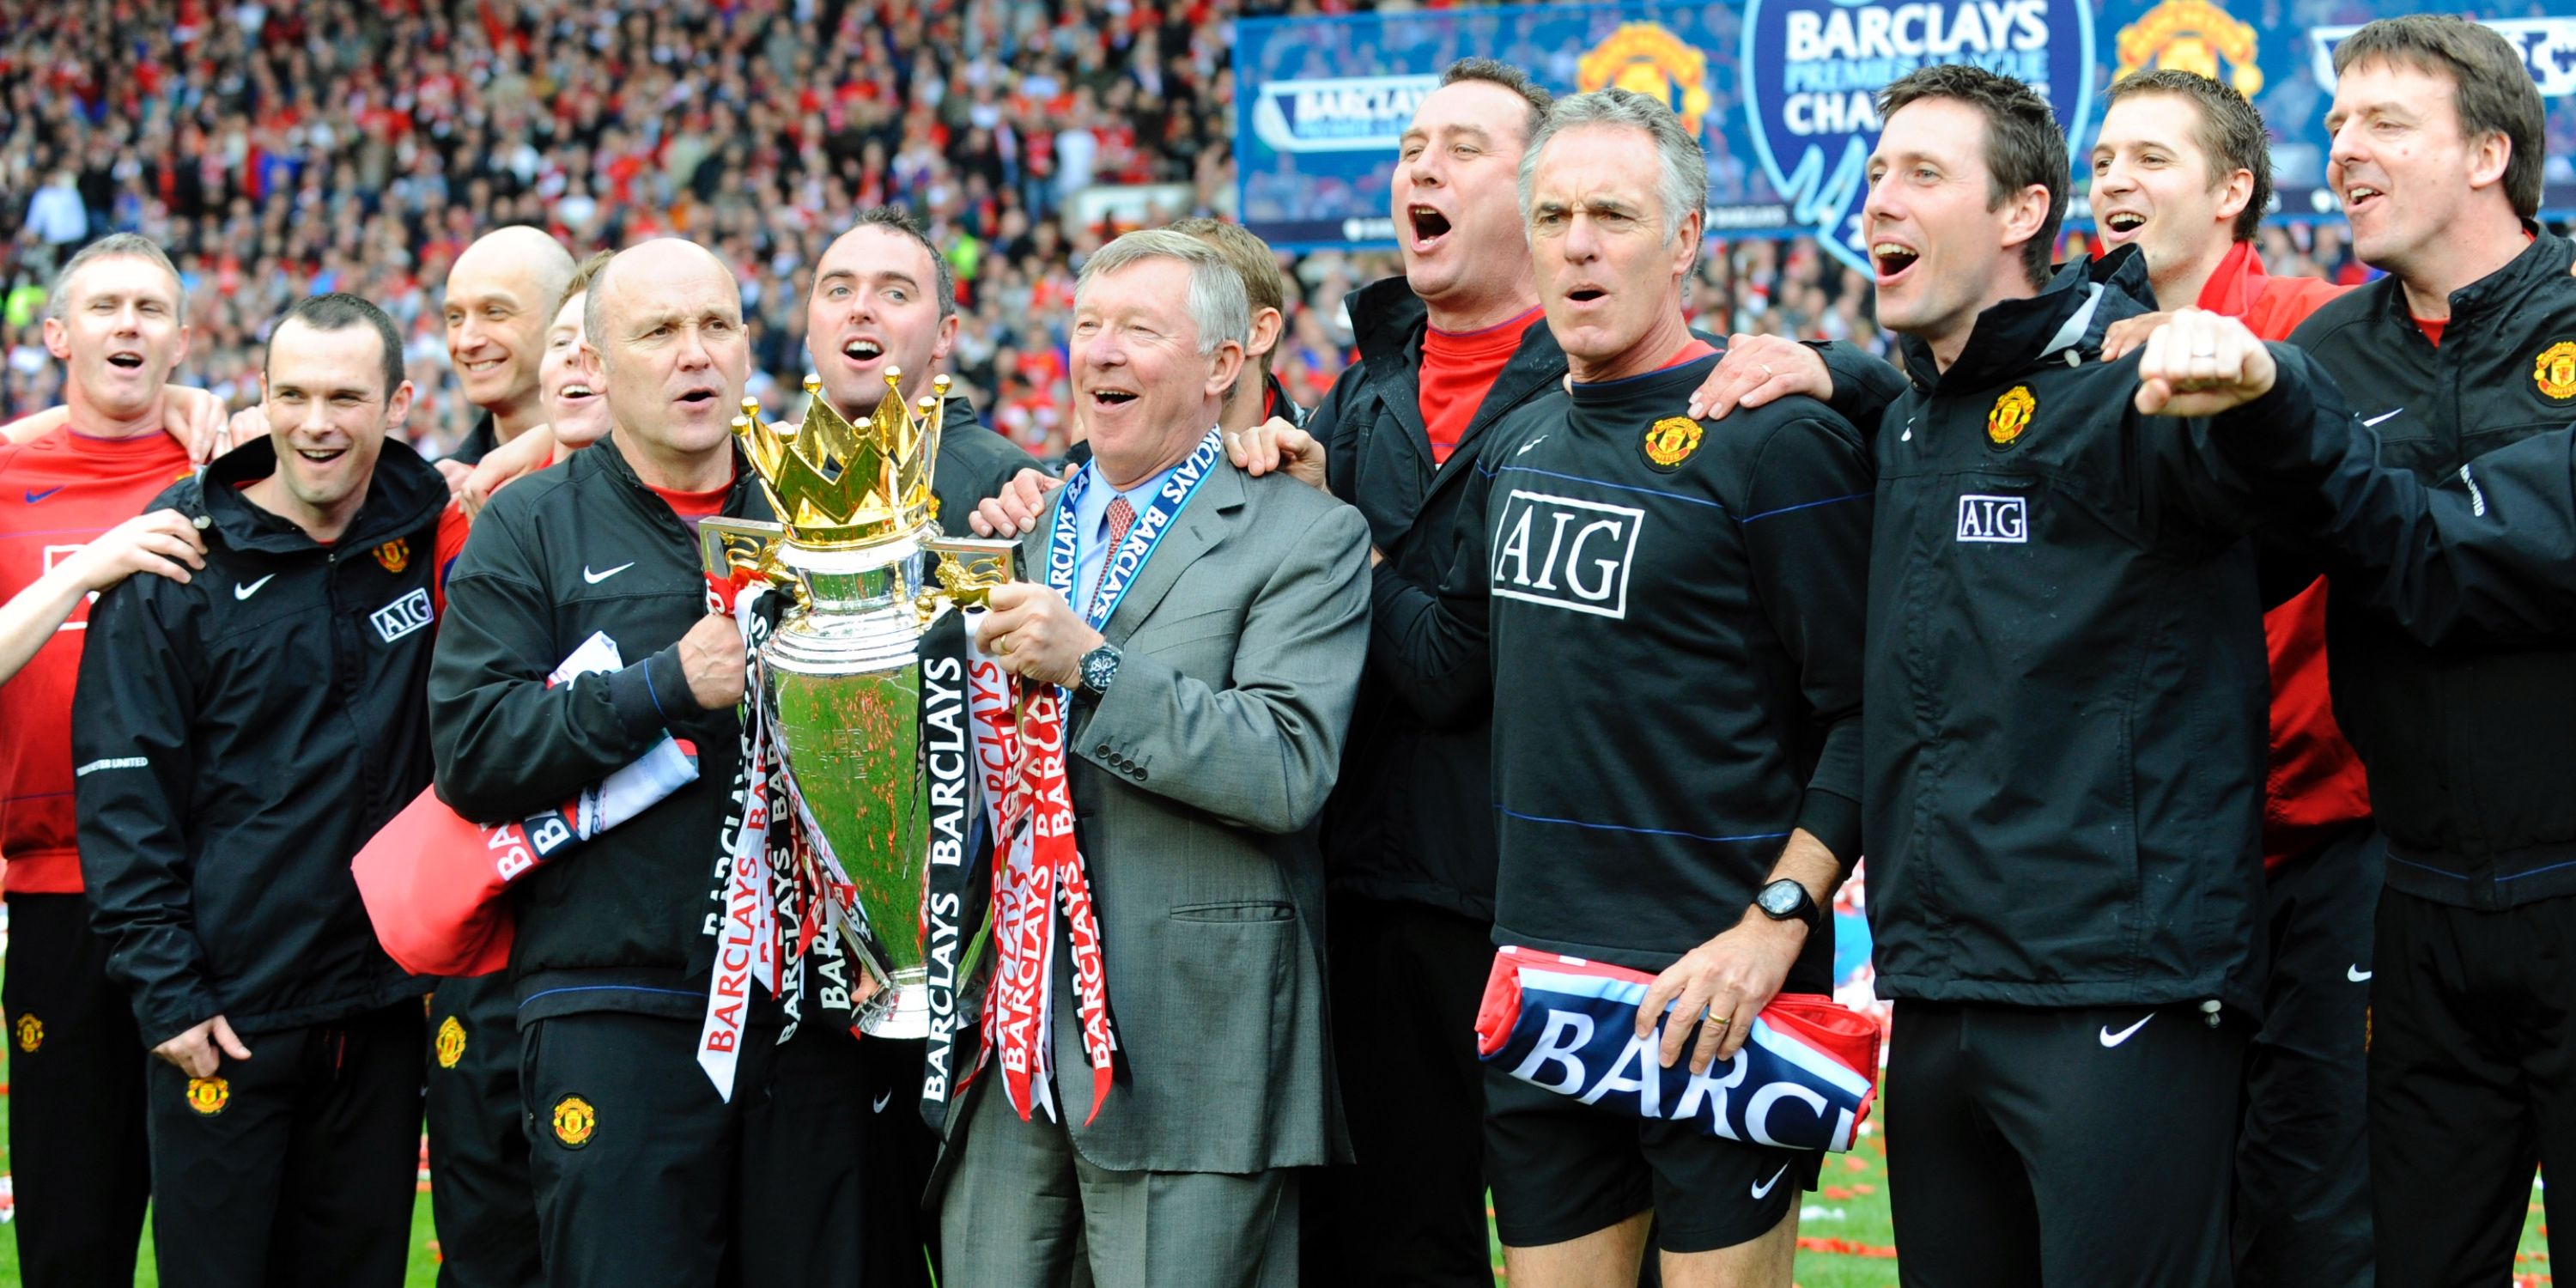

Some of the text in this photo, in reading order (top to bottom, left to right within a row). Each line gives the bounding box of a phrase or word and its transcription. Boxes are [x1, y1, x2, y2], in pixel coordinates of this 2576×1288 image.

[1785, 1, 2050, 61] BARCLAYS
[382, 594, 429, 636] AIG
[1094, 504, 1169, 620] BARCLAYS
[1495, 505, 1622, 601] AIG
[1961, 501, 2021, 538] AIG
[924, 657, 967, 866] BARCLAYS
[706, 856, 757, 1054] BARCLAYS
[772, 847, 801, 1046] BARCLAYS
[922, 893, 959, 1103] BARCLAYS
[1005, 863, 1050, 1074] BARCLAYS
[1059, 860, 1112, 1071] BARCLAYS
